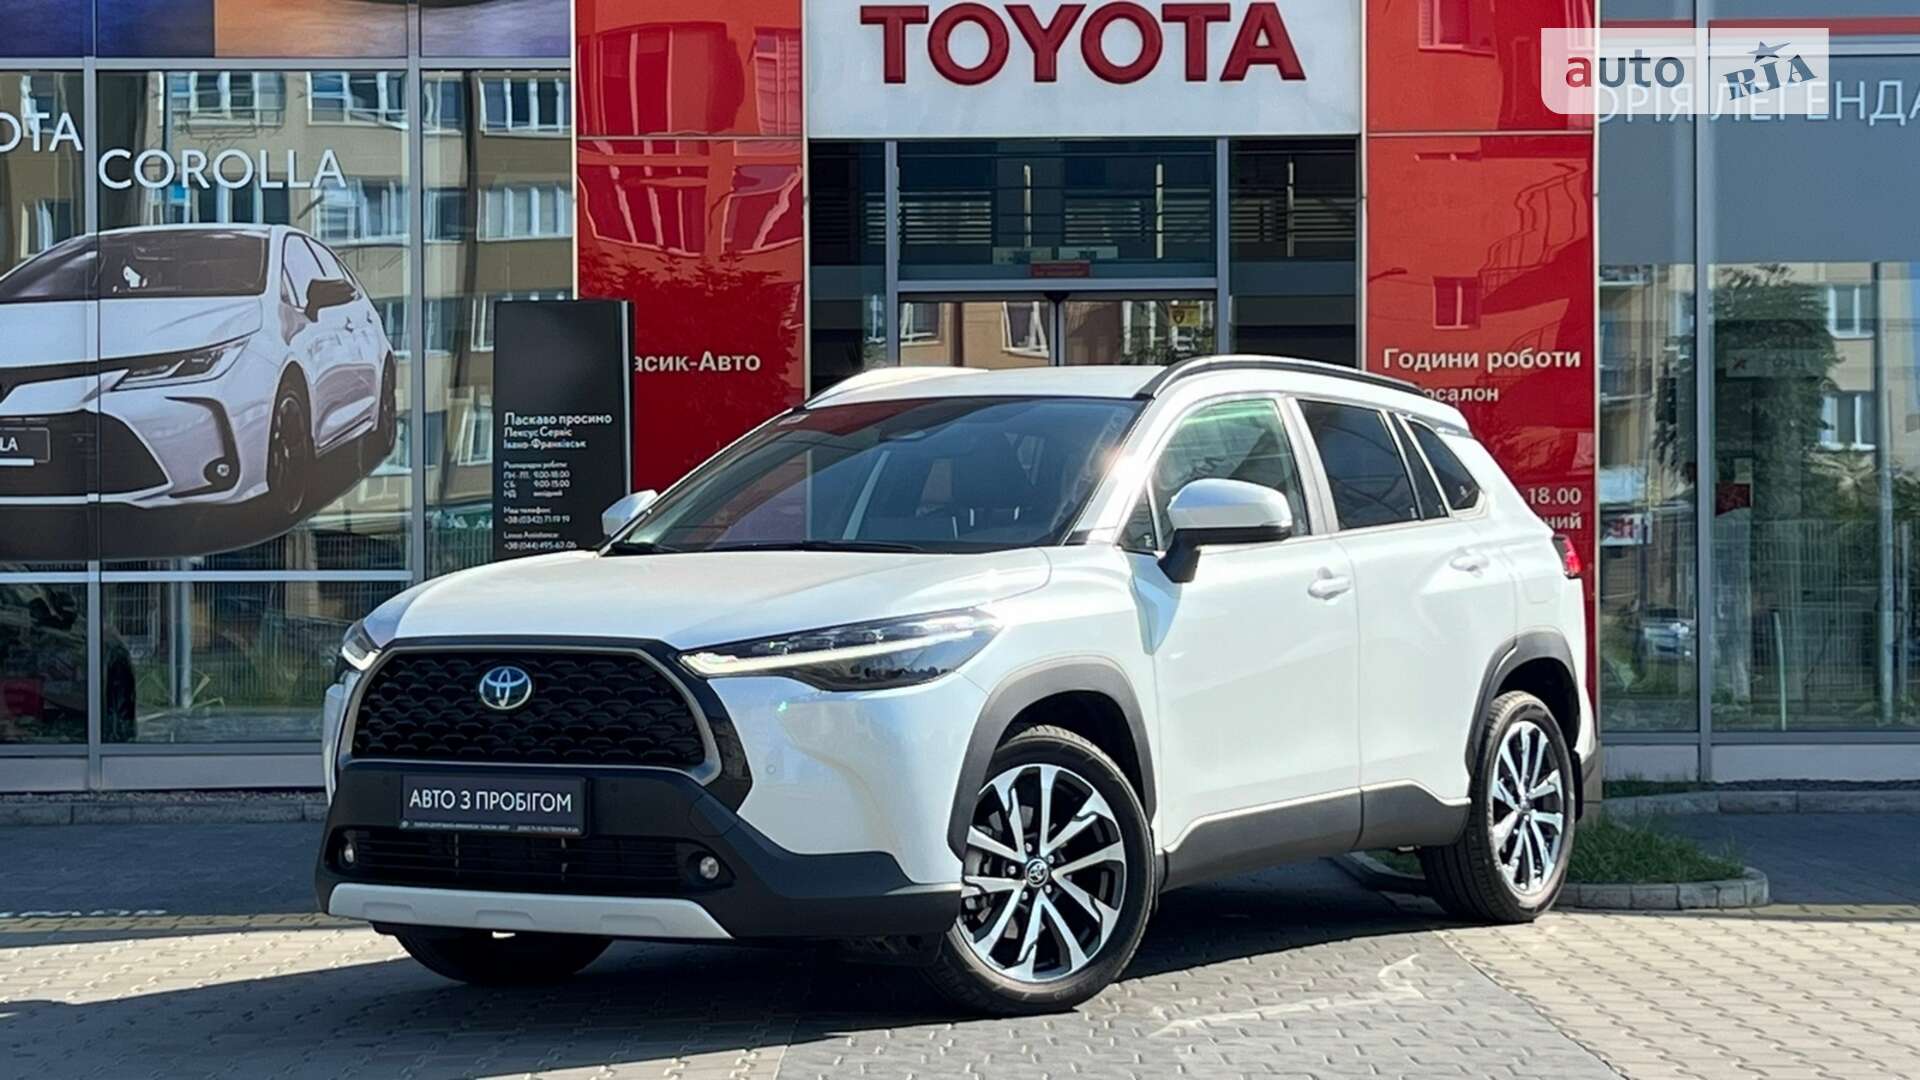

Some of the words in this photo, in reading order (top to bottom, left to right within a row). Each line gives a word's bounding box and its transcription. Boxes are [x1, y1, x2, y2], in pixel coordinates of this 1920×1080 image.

[860, 2, 1306, 85] TOYOTA
[98, 148, 347, 190] COROLLA
[1384, 348, 1479, 372] Години
[1487, 347, 1581, 373] роботи
[504, 412, 557, 426] Ласкаво
[559, 414, 613, 427] просимо
[1527, 486, 1582, 506] 18.00
[409, 789, 456, 810] АВТО
[475, 791, 573, 813] ПРОБІГОМ
